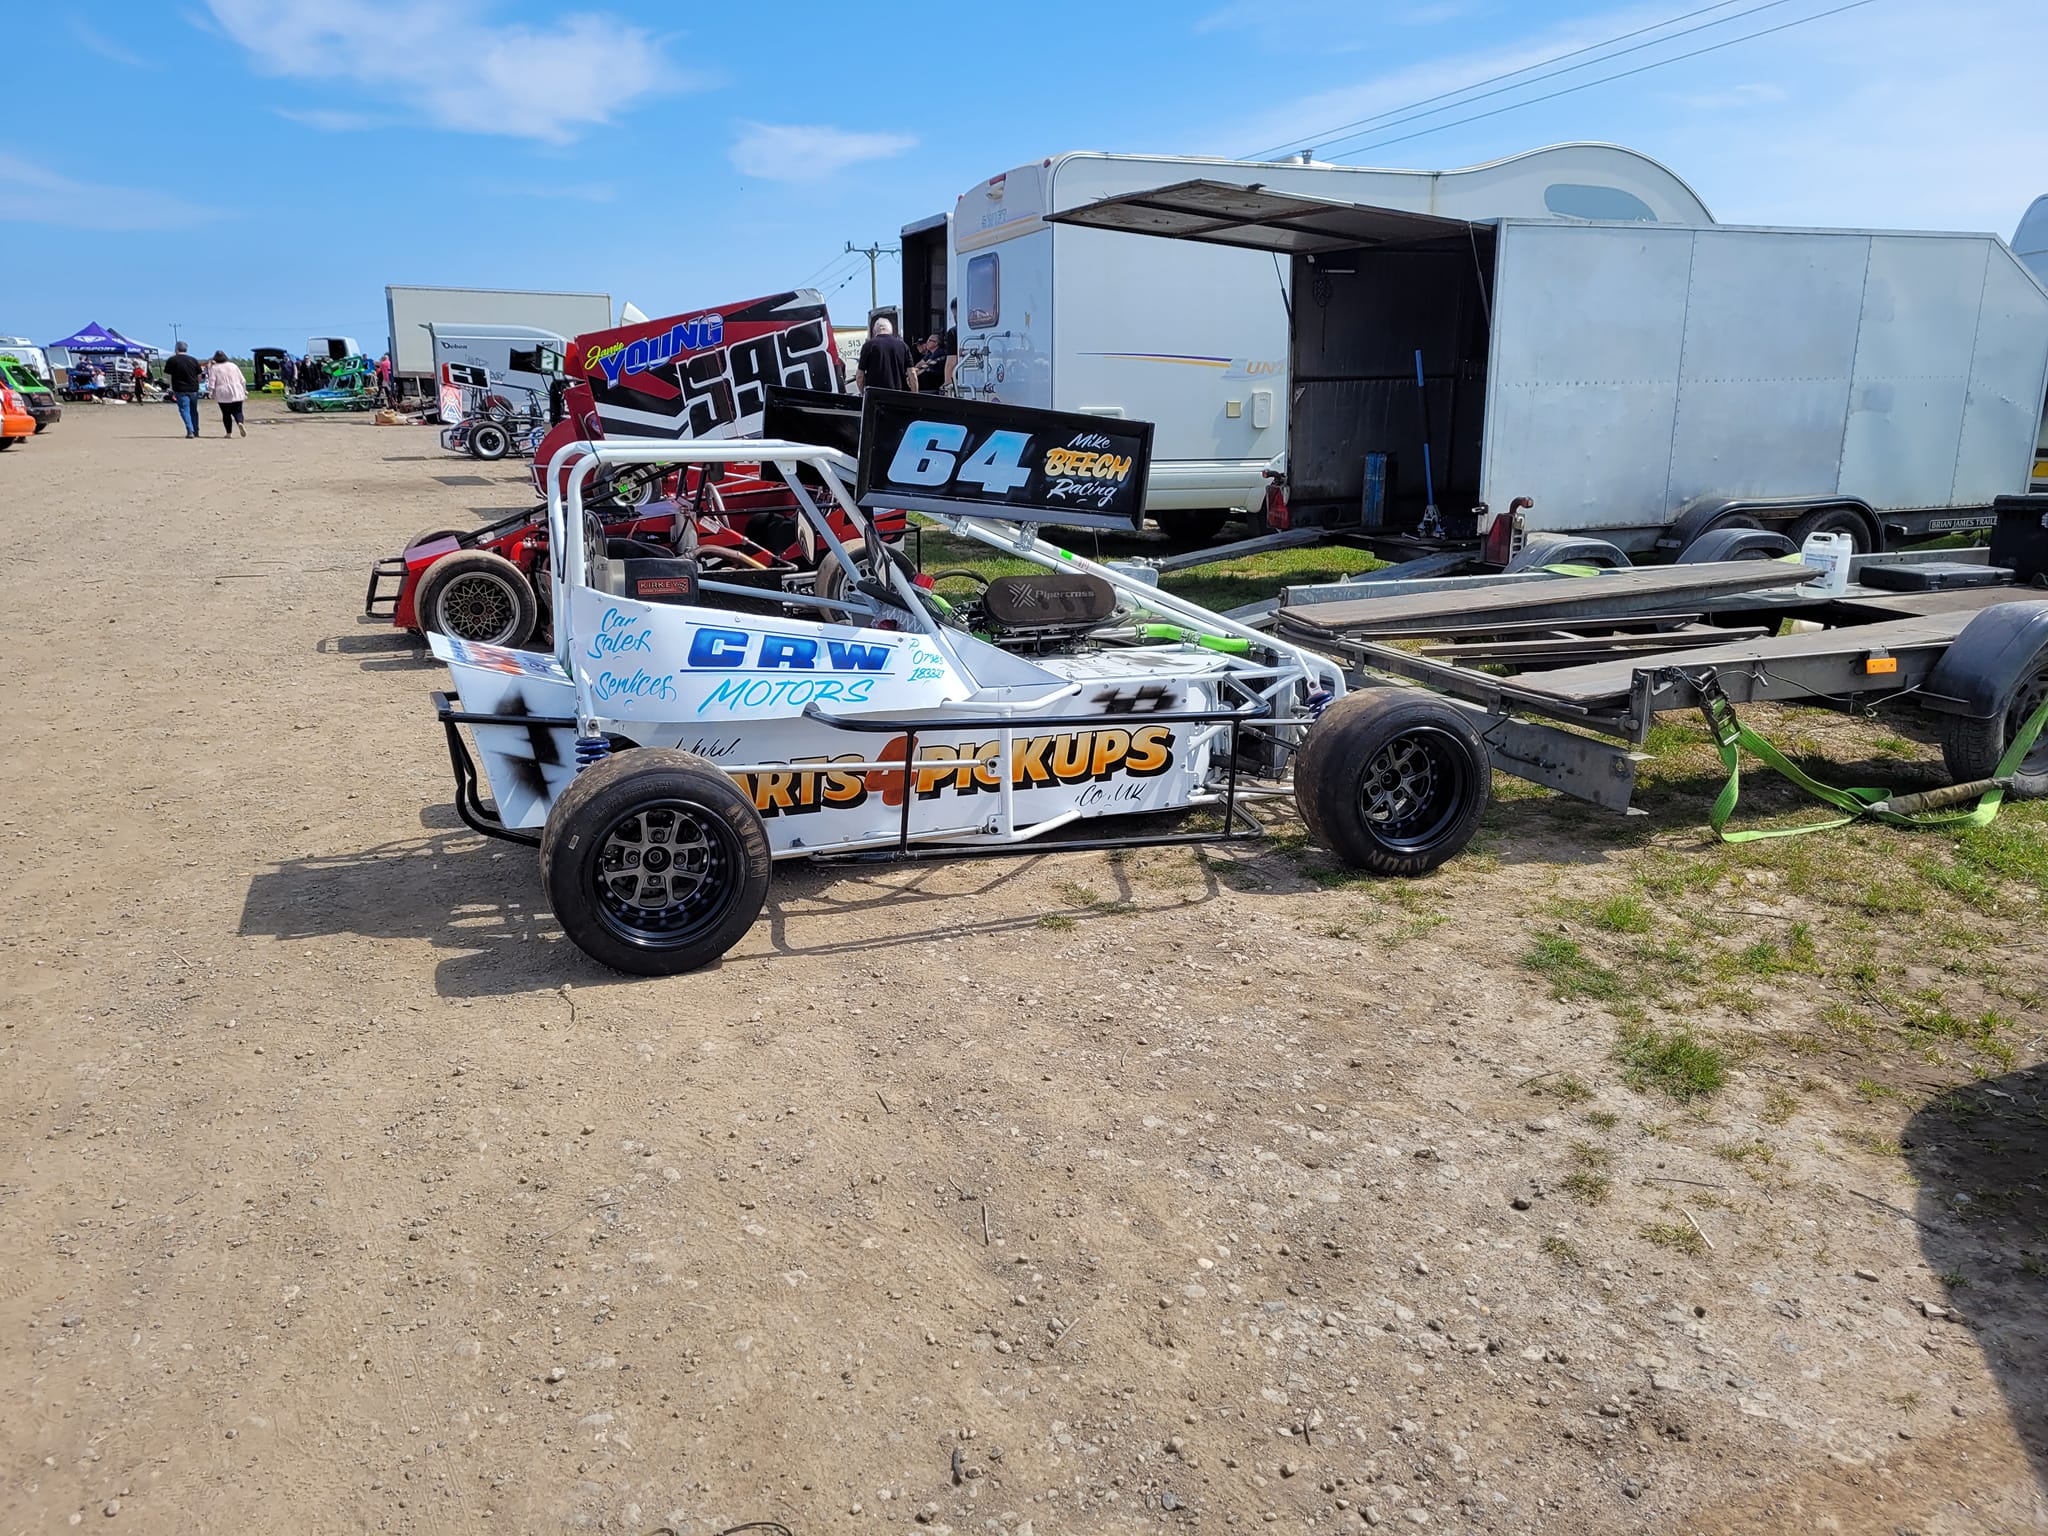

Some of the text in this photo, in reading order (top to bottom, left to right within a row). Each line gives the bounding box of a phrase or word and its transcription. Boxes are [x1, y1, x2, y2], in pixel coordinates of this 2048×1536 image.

[584, 341, 624, 370] Jamie
[600, 313, 724, 390] YOUNG
[847, 339, 861, 348] 513
[675, 317, 839, 438] 595
[1067, 432, 1111, 450] Mike
[887, 420, 1034, 494] 64
[1044, 447, 1132, 482] BEECH
[1047, 478, 1118, 507] Racing
[1931, 519, 1952, 529] BRIAN
[1953, 519, 1974, 528] JAMES
[640, 581, 681, 593] KIRKEY
[1035, 589, 1096, 601] Pipercross
[601, 607, 638, 632] Car
[587, 630, 652, 659] Sales
[687, 627, 890, 671] CRW
[594, 667, 677, 702] Services
[697, 678, 875, 714] MOTORS
[724, 803, 769, 880] AVON
